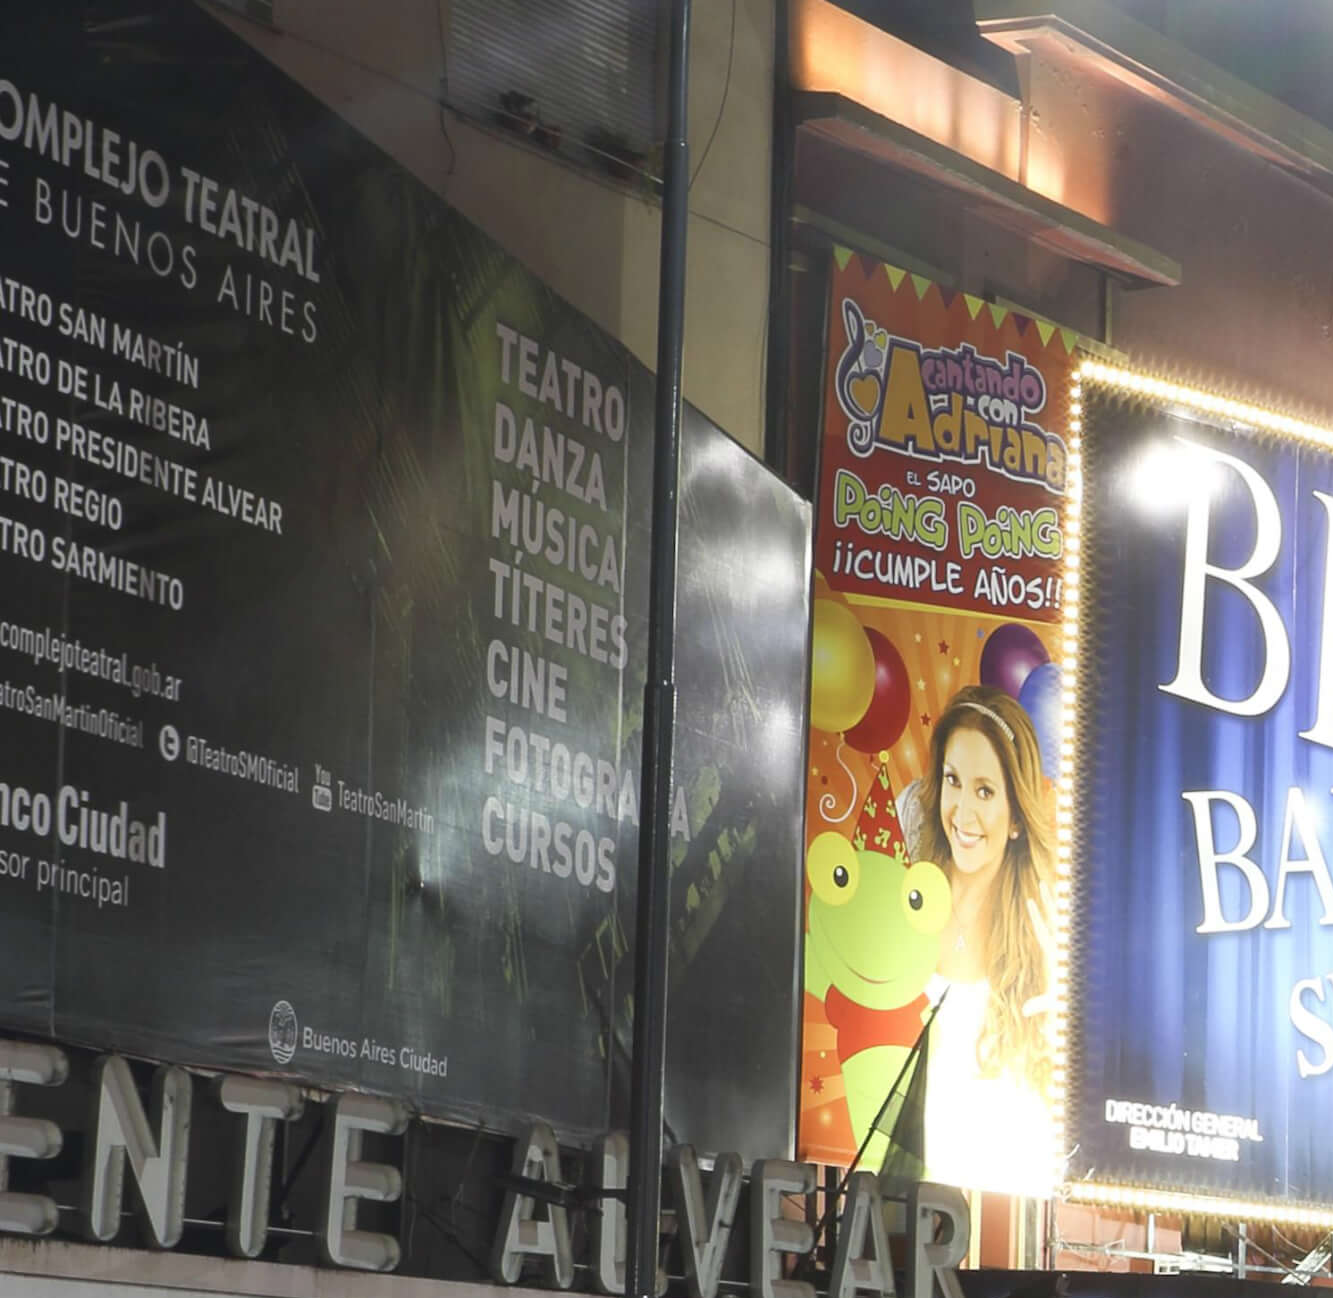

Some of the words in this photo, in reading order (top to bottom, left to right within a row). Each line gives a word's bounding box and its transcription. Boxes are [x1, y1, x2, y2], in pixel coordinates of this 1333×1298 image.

[36, 178, 197, 289] BUENOS
[217, 265, 317, 343] AIRES
[181, 166, 320, 282] TEATRAL
[59, 303, 106, 349] SAN
[113, 322, 199, 389] MARTÍN
[497, 323, 625, 442] TEATRO
[920, 350, 1043, 408] cantando
[58, 360, 88, 400] DE
[95, 374, 124, 415] LA
[129, 388, 211, 450] RIBERA
[878, 342, 1070, 487] Adriana
[977, 394, 1019, 427] con
[0, 396, 49, 444] TRO
[56, 418, 198, 502] PRESIDENTE
[202, 476, 283, 534] ALVEAR
[495, 402, 607, 512] DANZA
[907, 472, 921, 485] EL
[927, 471, 976, 497] SAPO
[54, 477, 123, 530] REGIO
[492, 478, 621, 594] MÚSICA
[51, 536, 185, 611] SARMIENTO
[489, 550, 629, 670] TÍTERES
[487, 639, 568, 723] CINE
[186, 735, 300, 793] @TeatroSMOficial
[337, 780, 435, 834] TeatroSanMartin
[485, 716, 690, 842] FOTOGRAA
[57, 784, 167, 869] Ciudad
[482, 797, 616, 893] CURSOS
[37, 857, 129, 908] principal
[302, 1027, 357, 1060] Buenos
[360, 1040, 397, 1066] Aires
[400, 1047, 448, 1078] Ciudad
[1105, 1099, 1190, 1131] DIRECCIÓN
[1191, 1111, 1263, 1141] GENERAL
